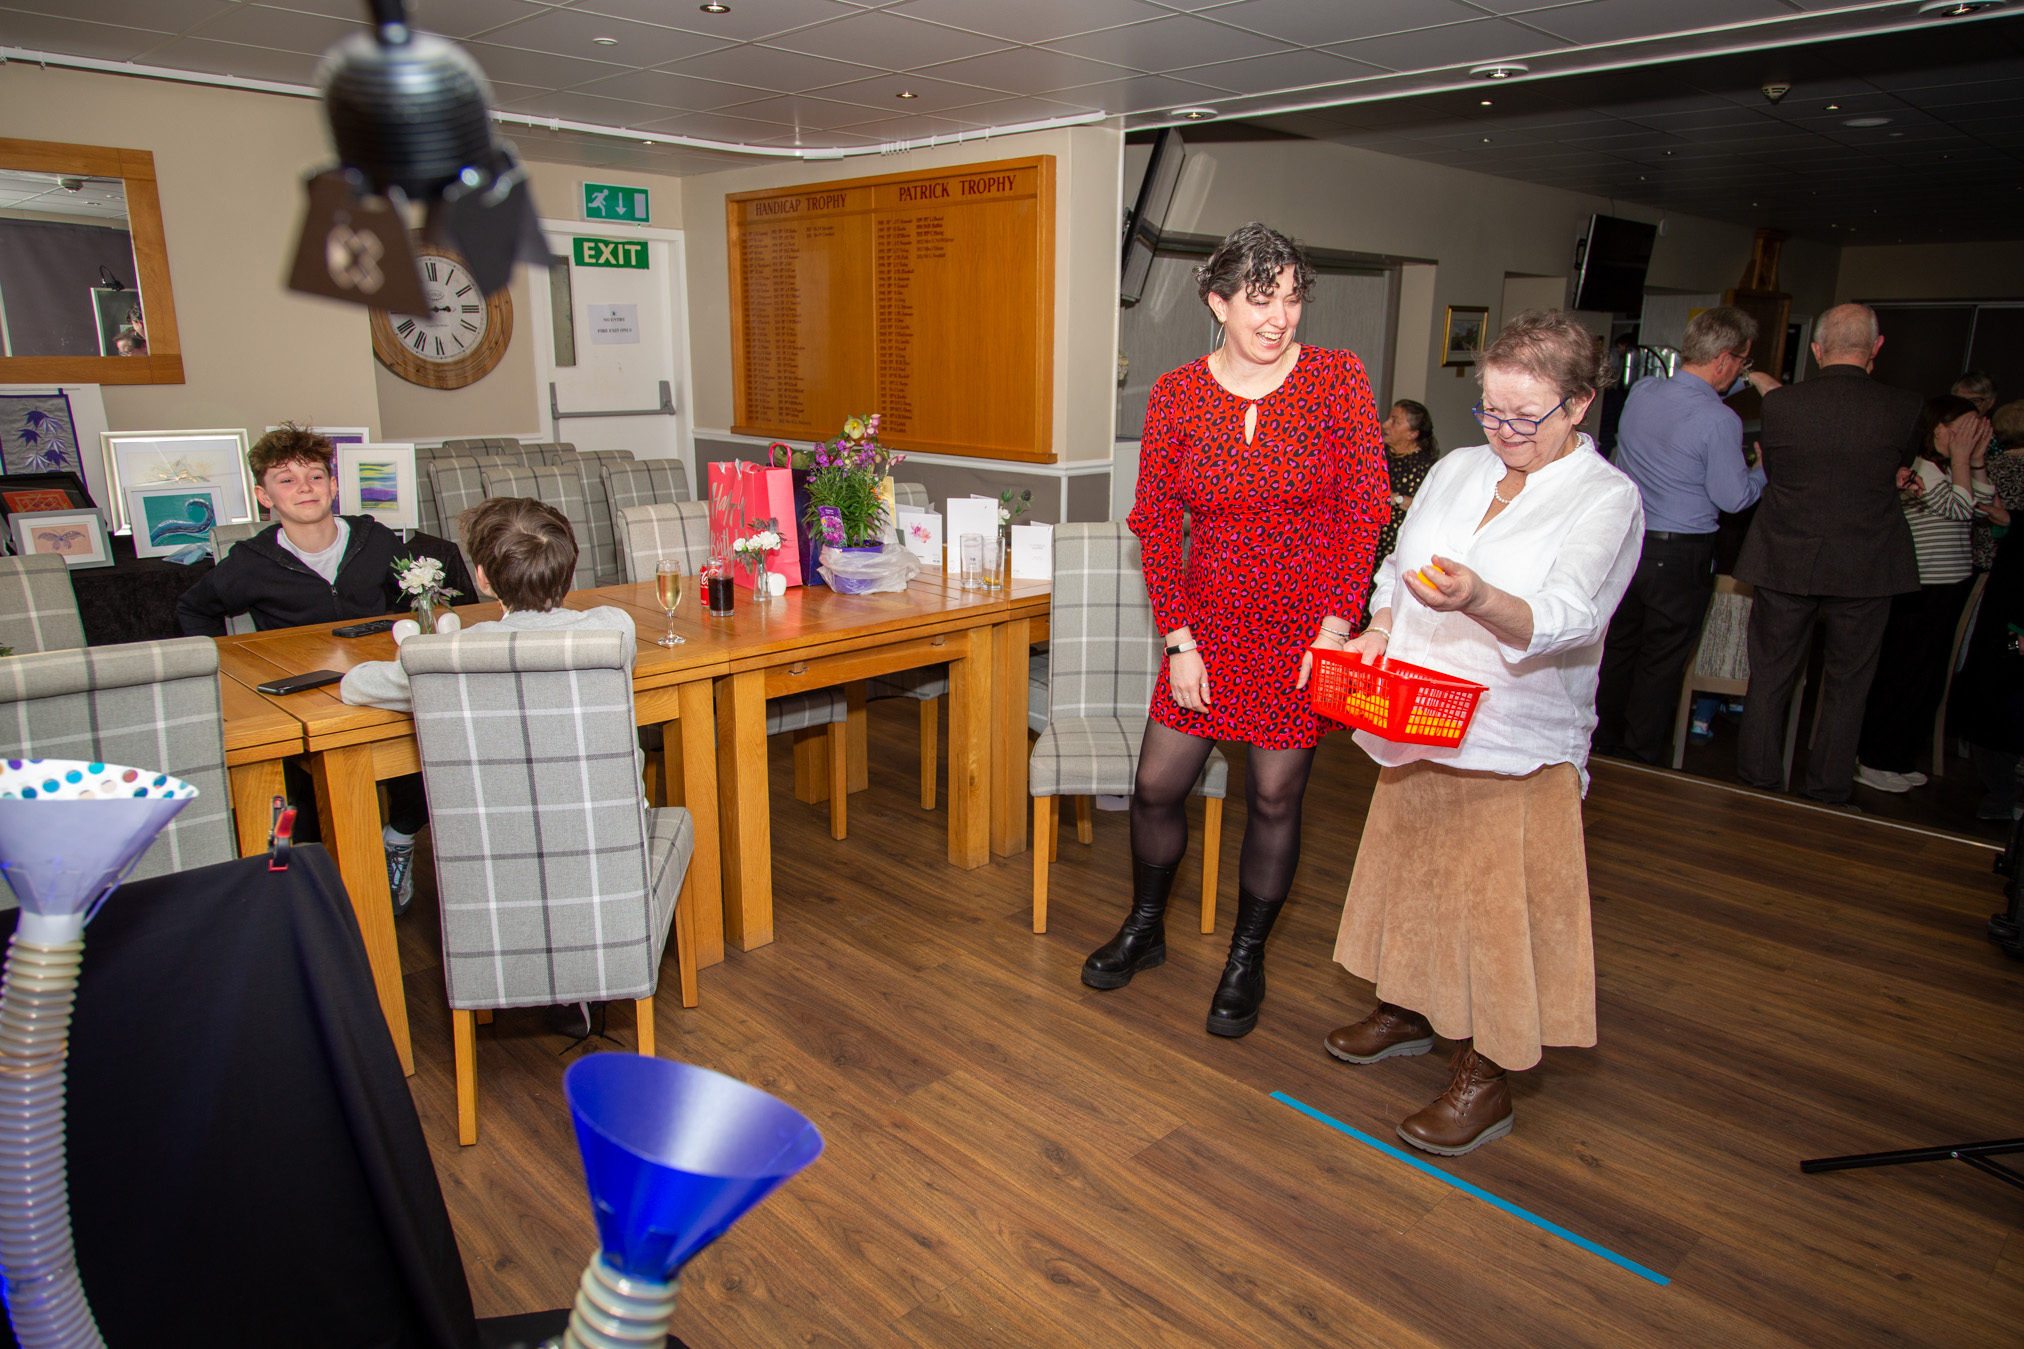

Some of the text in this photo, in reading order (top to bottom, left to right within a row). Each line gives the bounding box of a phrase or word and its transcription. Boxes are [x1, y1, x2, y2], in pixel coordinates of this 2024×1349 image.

[899, 175, 1017, 202] PATRICK TROPHY
[755, 193, 847, 217] HANDICAP TROPHY
[583, 242, 642, 265] EXIT
[461, 304, 480, 313] III
